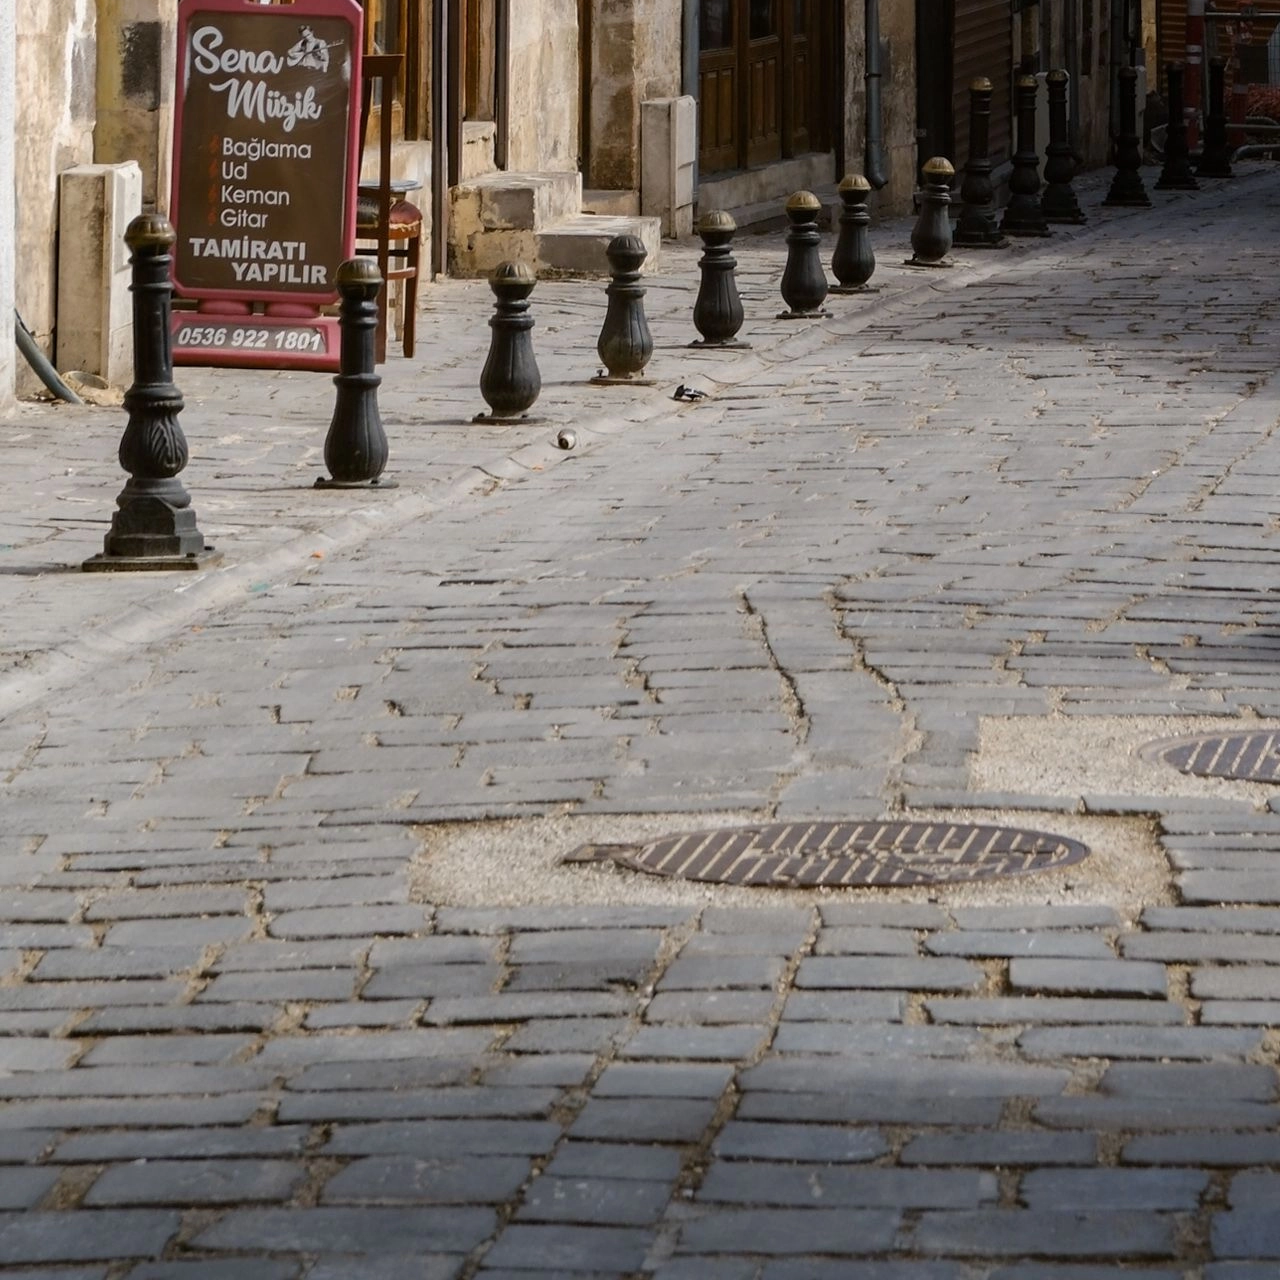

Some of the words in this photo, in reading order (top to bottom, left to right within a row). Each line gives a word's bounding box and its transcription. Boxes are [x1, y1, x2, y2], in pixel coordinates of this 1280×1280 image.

[192, 25, 284, 74] Sena
[209, 78, 322, 132] Müzik
[223, 137, 312, 161] Bağlama
[222, 161, 248, 179] Ud
[221, 185, 290, 205] Keman
[220, 208, 268, 228] Gitar
[189, 236, 306, 261] TAMİRATI
[232, 262, 327, 285] YAPILIR
[178, 327, 227, 346] 0536
[231, 328, 269, 348] 922
[274, 331, 321, 351] 1801
